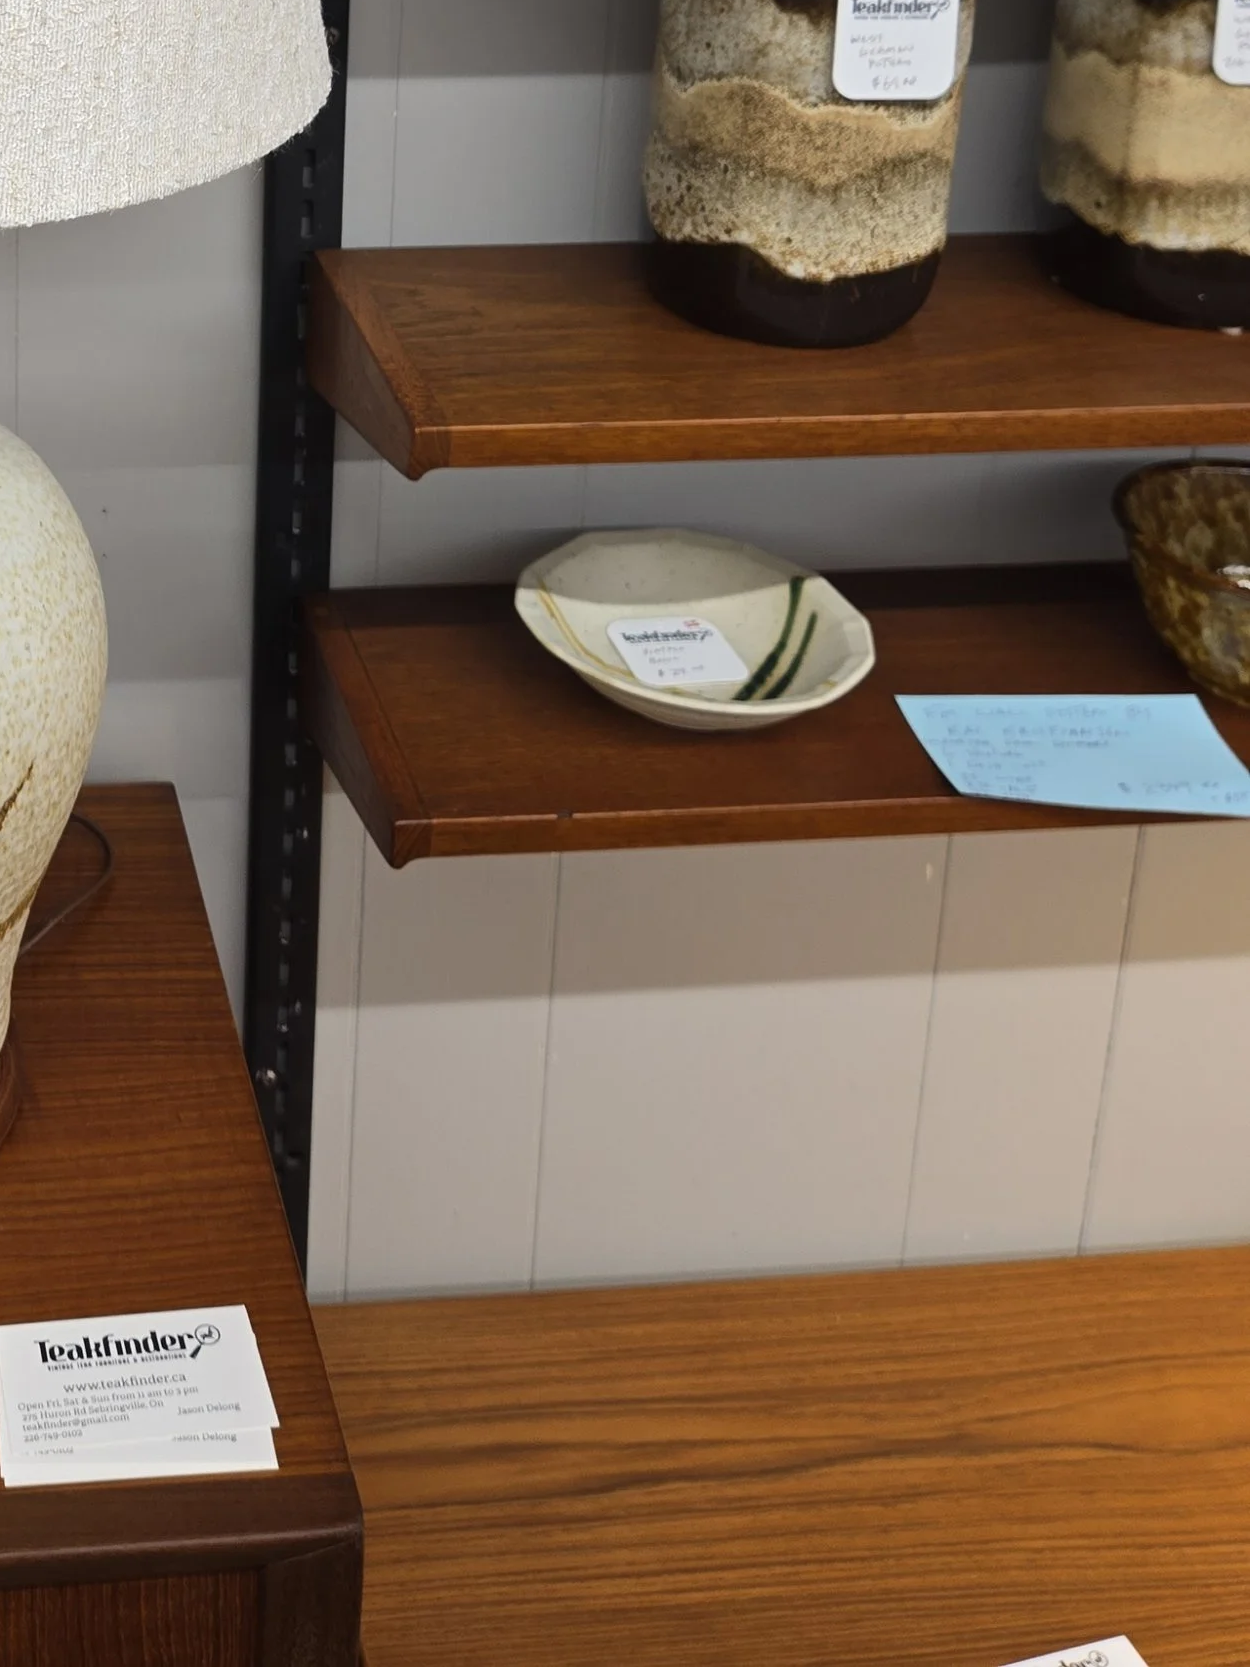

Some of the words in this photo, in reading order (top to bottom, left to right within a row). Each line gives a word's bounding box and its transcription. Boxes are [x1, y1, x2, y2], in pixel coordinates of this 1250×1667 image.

[34, 1330, 194, 1364] Teakfinder
[63, 1373, 187, 1393] www.teakfinder.ca
[18, 1401, 44, 1413] Open
[63, 1397, 79, 1407] Sat
[81, 1396, 89, 1405] &
[91, 1394, 110, 1404] Sun
[111, 1392, 136, 1402] from
[147, 1390, 162, 1399] am
[164, 1387, 174, 1396] to
[183, 1386, 199, 1396] pm
[40, 1408, 72, 1420] Huron
[74, 1406, 87, 1416] Rd
[88, 1401, 148, 1414] Sebringville,
[149, 1399, 164, 1408] On
[177, 1406, 205, 1416] Jason
[206, 1401, 241, 1412] Delong
[22, 1413, 130, 1432] teakfinder@gmail.com
[202, 1432, 237, 1443] Delong
